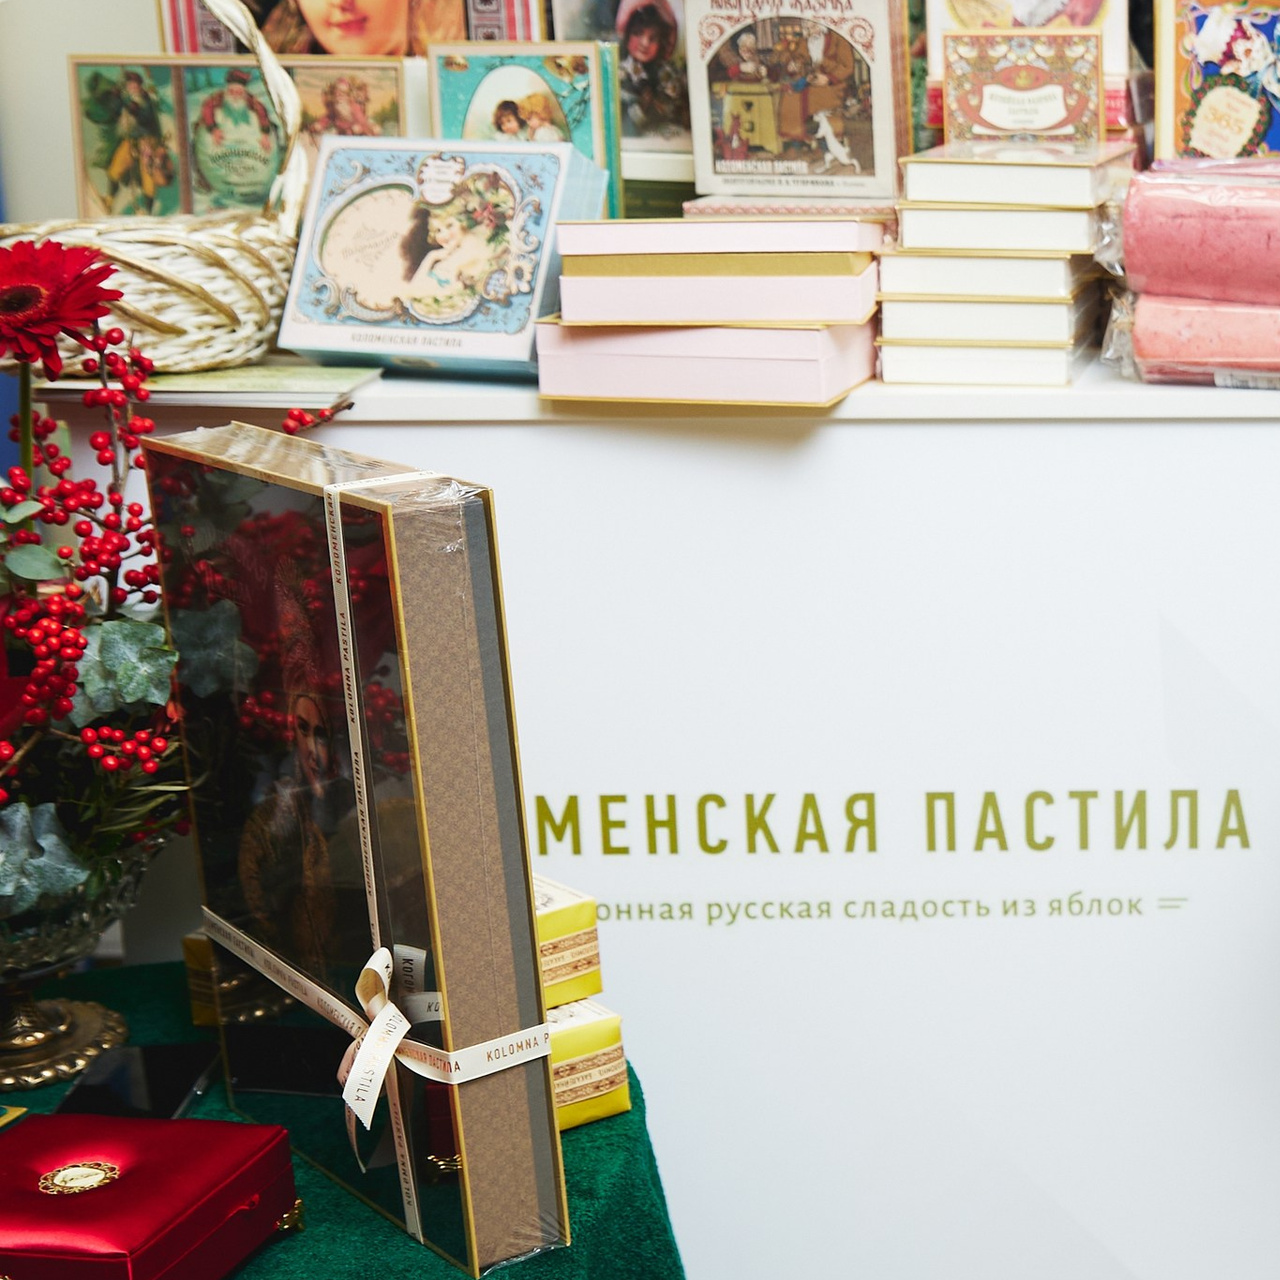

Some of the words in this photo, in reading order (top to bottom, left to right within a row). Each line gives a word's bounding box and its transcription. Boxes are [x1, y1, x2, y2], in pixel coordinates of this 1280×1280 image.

[535, 793, 878, 857] МЕНСКАЯ
[926, 789, 1252, 854] ПАСТИЛА
[596, 901, 694, 922] онная
[706, 899, 832, 926] русская
[844, 895, 990, 922] сладость
[1003, 898, 1037, 918] из
[1048, 892, 1144, 917] яблок
[486, 1036, 539, 1062] KOLOMNA
